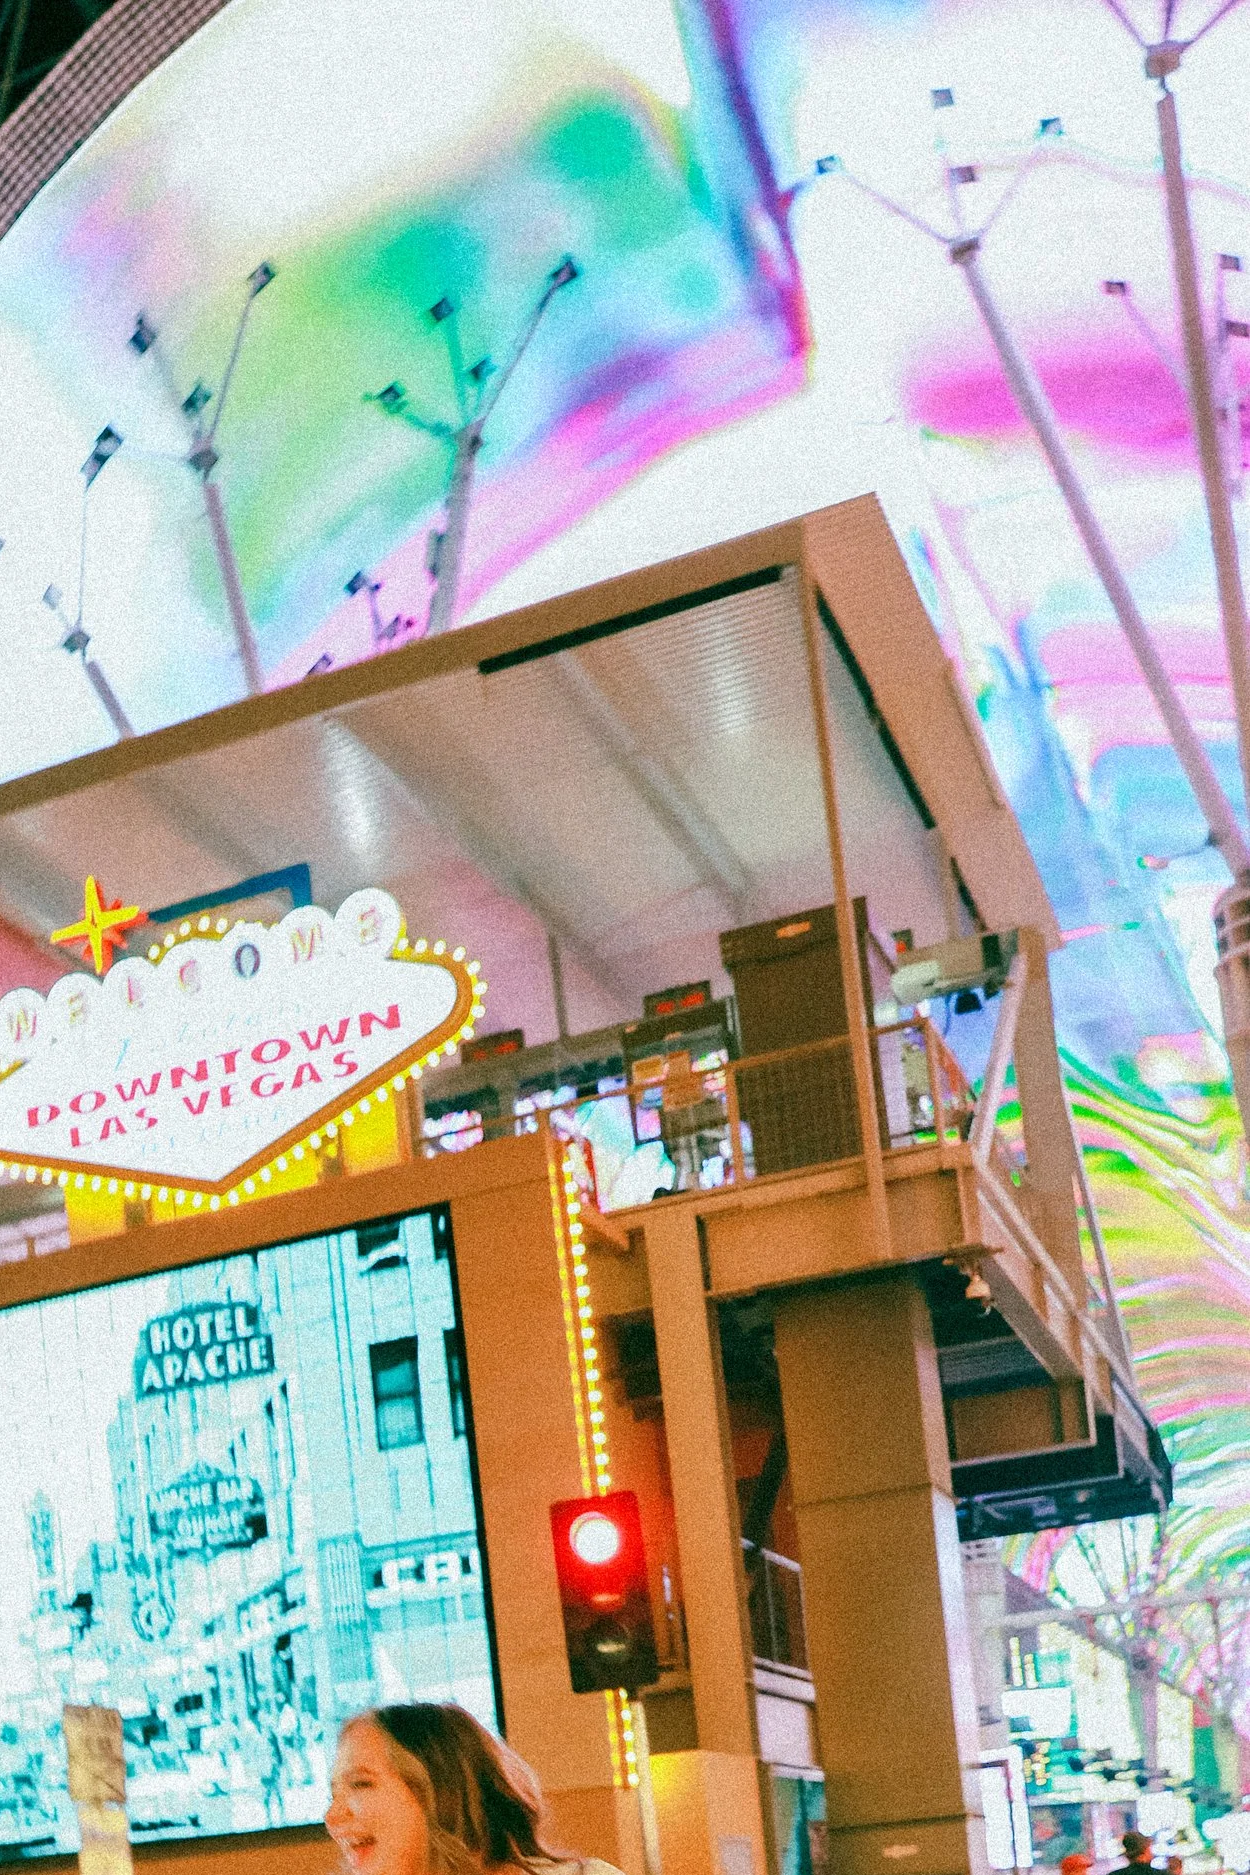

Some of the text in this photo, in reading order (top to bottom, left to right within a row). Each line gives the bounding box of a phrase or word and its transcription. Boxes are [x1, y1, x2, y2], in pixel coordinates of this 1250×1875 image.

[25, 1003, 402, 1130] DOWNTOWN
[68, 1108, 161, 1150] LAS
[181, 1049, 361, 1118] VEGAS
[142, 1338, 269, 1390] APACHE
[149, 1305, 254, 1356] HOTEL
